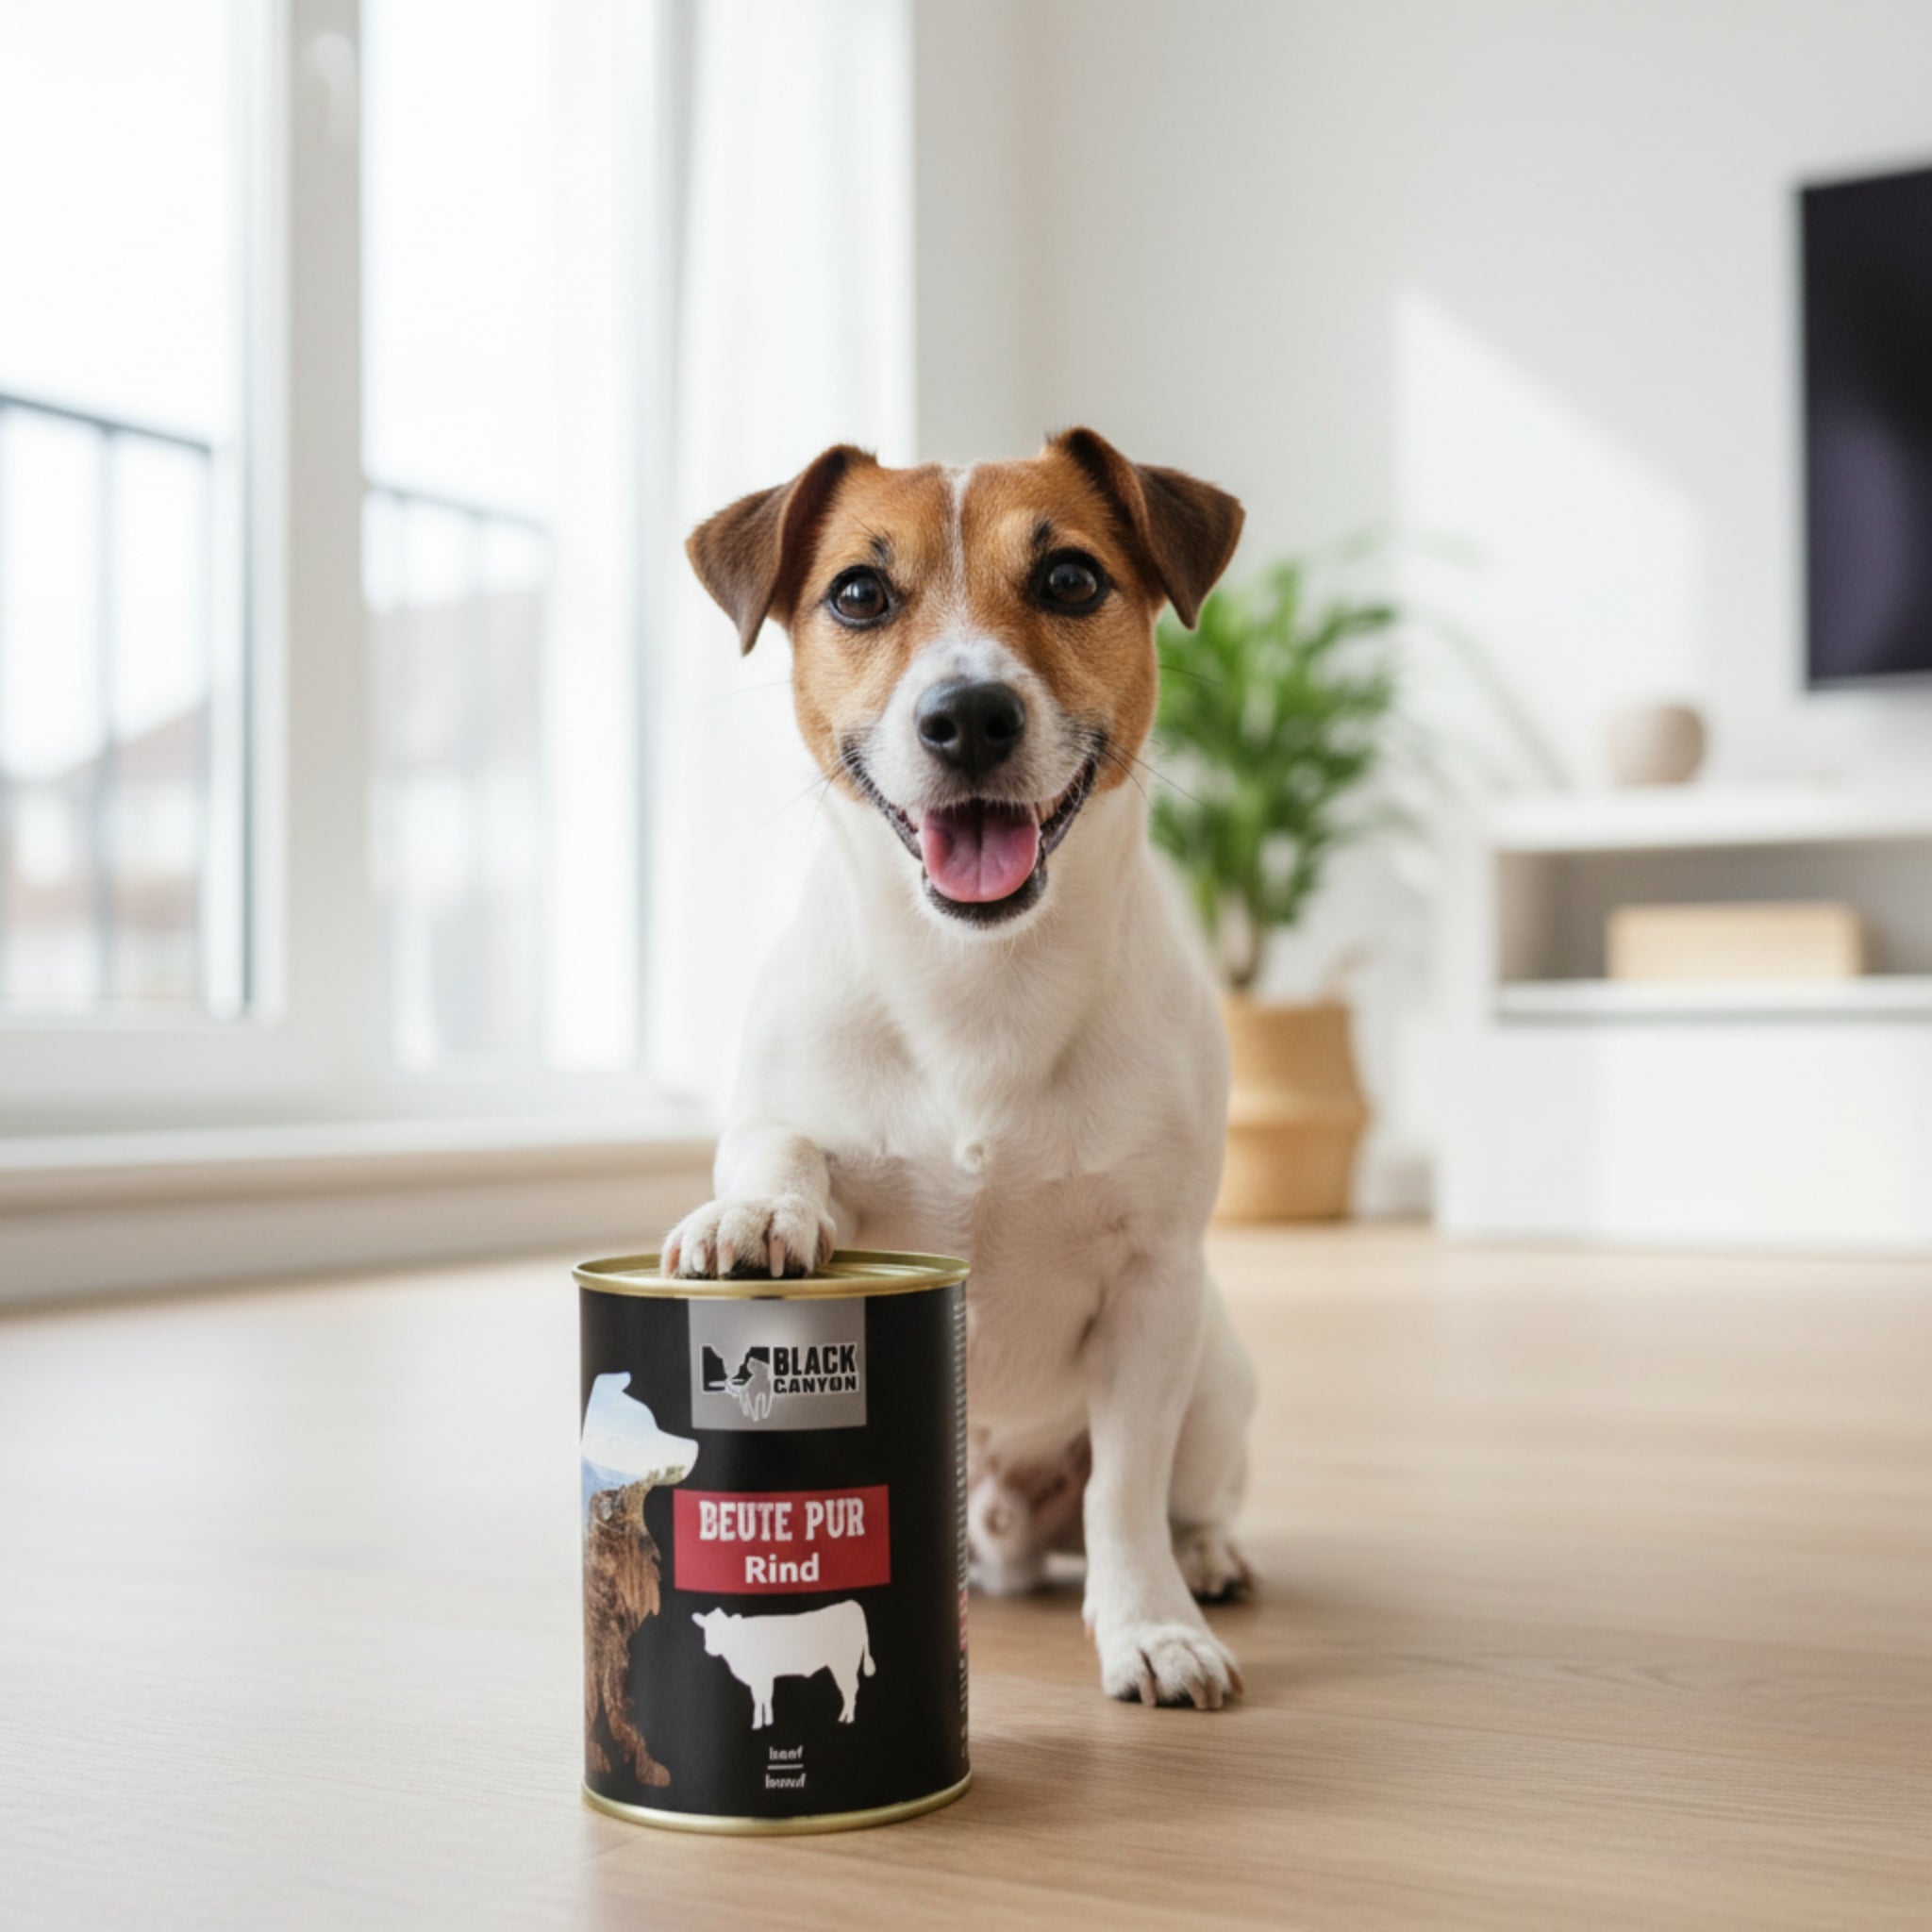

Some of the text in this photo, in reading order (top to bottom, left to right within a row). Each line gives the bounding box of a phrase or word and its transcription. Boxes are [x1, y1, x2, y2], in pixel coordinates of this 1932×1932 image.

[773, 1344, 856, 1375] BLACK
[773, 1375, 857, 1393] CANYON
[699, 1497, 865, 1541] BEUTE PUR
[745, 1552, 820, 1584] Rind
